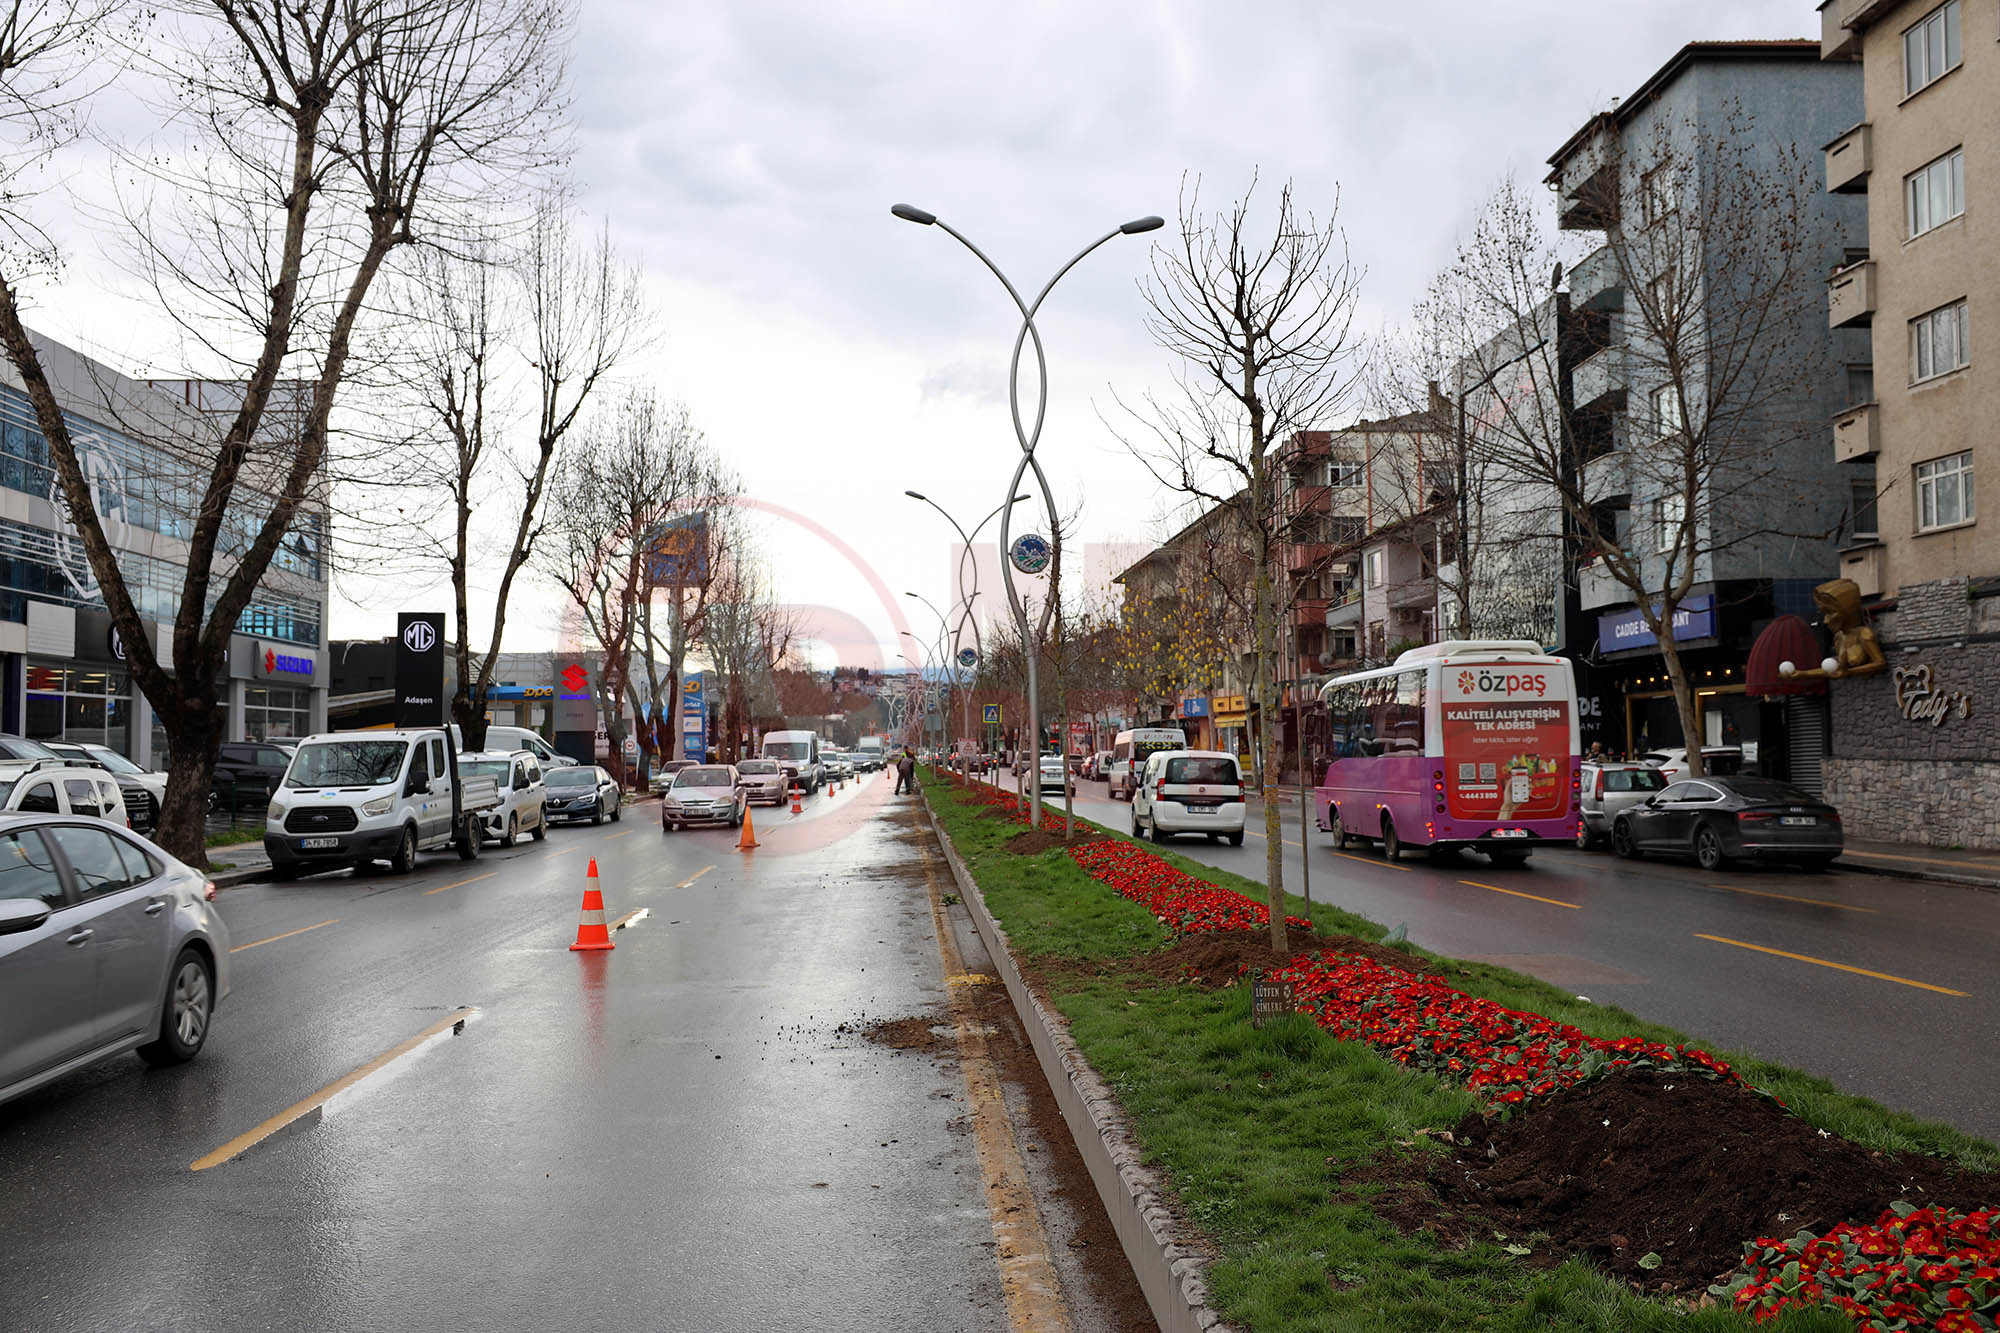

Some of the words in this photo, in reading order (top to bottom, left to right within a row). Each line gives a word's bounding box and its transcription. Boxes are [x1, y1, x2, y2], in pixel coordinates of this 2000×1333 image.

[407, 623, 432, 649] MG
[1615, 621, 1639, 638] CADDE
[276, 653, 312, 675] SUZUKI
[1479, 670, 1546, 697] özpaş
[405, 696, 432, 706] Adaşen
[1447, 708, 1494, 720] KALİTELİ
[1495, 707, 1560, 721] ALIŞVERİŞİN
[1474, 721, 1495, 731] TEK
[1496, 719, 1535, 731] ADRESİ
[1255, 984, 1280, 997] LÜTFEN
